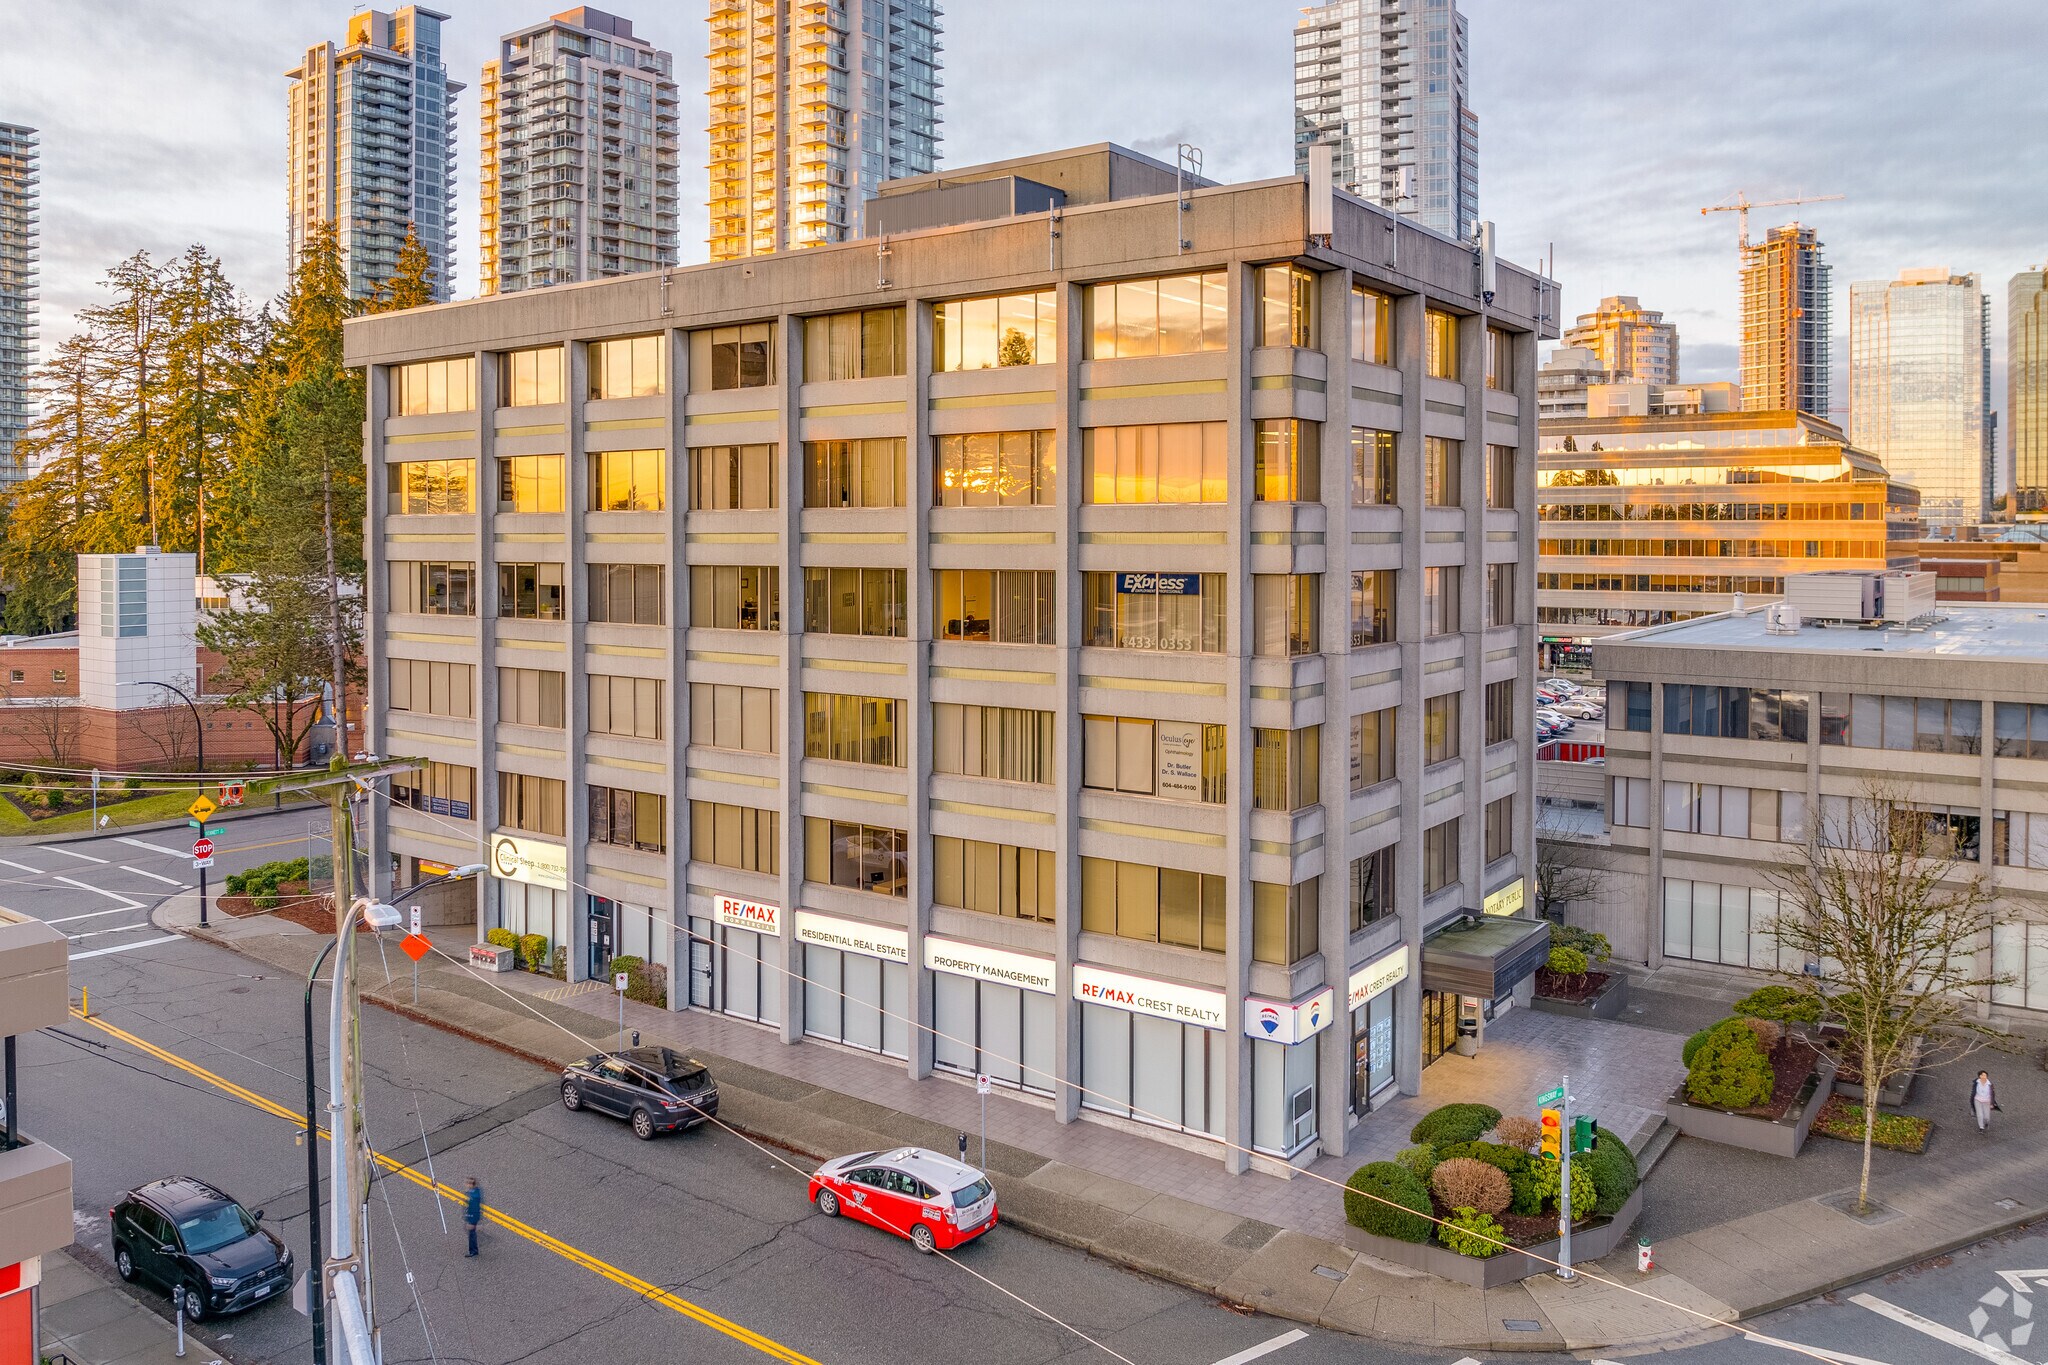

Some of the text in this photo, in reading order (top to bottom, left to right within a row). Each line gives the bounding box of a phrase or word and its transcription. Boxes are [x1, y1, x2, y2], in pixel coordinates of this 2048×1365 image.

[1161, 734, 1182, 743] Oculus
[1177, 770, 1197, 778] Wallace
[194, 844, 213, 854] STOP
[500, 853, 519, 863] Clinical
[520, 857, 535, 869] Sleep
[723, 900, 775, 924] RE/MAX
[1485, 888, 1522, 914] NOTARY PUBLIC
[724, 916, 775, 932] COMMERCIAL
[802, 928, 906, 958] RESIDENTIAL REAL ESTATE
[934, 956, 1050, 987] PROPERTY MANAGEMENT
[1348, 965, 1404, 1006] E/MAX CREST REALTY
[1082, 983, 1220, 1022] RE/MAX CREST REALTY
